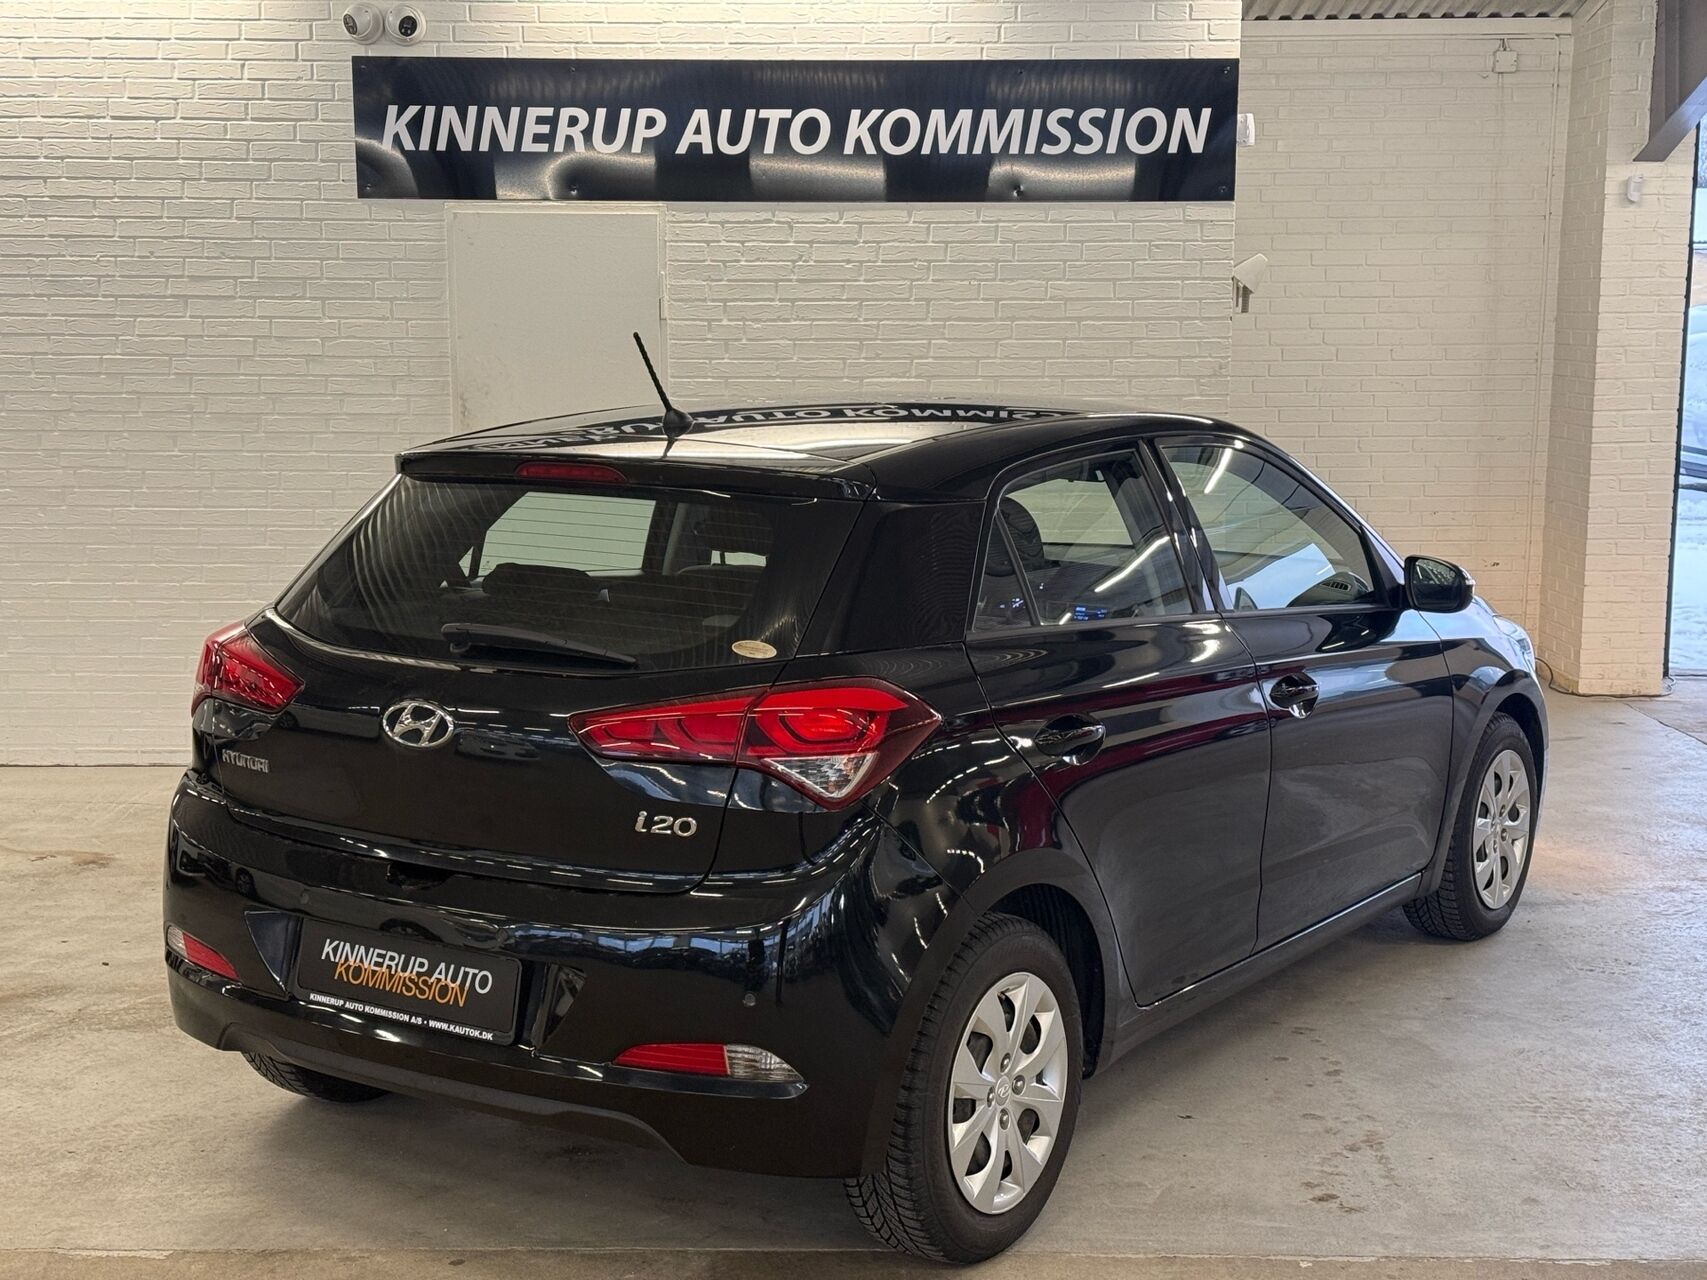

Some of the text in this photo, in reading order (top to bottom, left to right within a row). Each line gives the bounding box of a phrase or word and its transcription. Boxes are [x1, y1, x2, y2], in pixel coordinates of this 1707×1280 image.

[382, 104, 1212, 155] KINNERUP AUTO KOMMISSION
[222, 748, 269, 773] HYUNDAI
[634, 810, 698, 837] i20
[321, 938, 493, 994] KINNERUP AUTO
[334, 959, 469, 1007] KOMMISSION
[309, 993, 494, 1041] KINNERUP AUTO KOMMISSION A/S WWW.KAUTOK.DK
